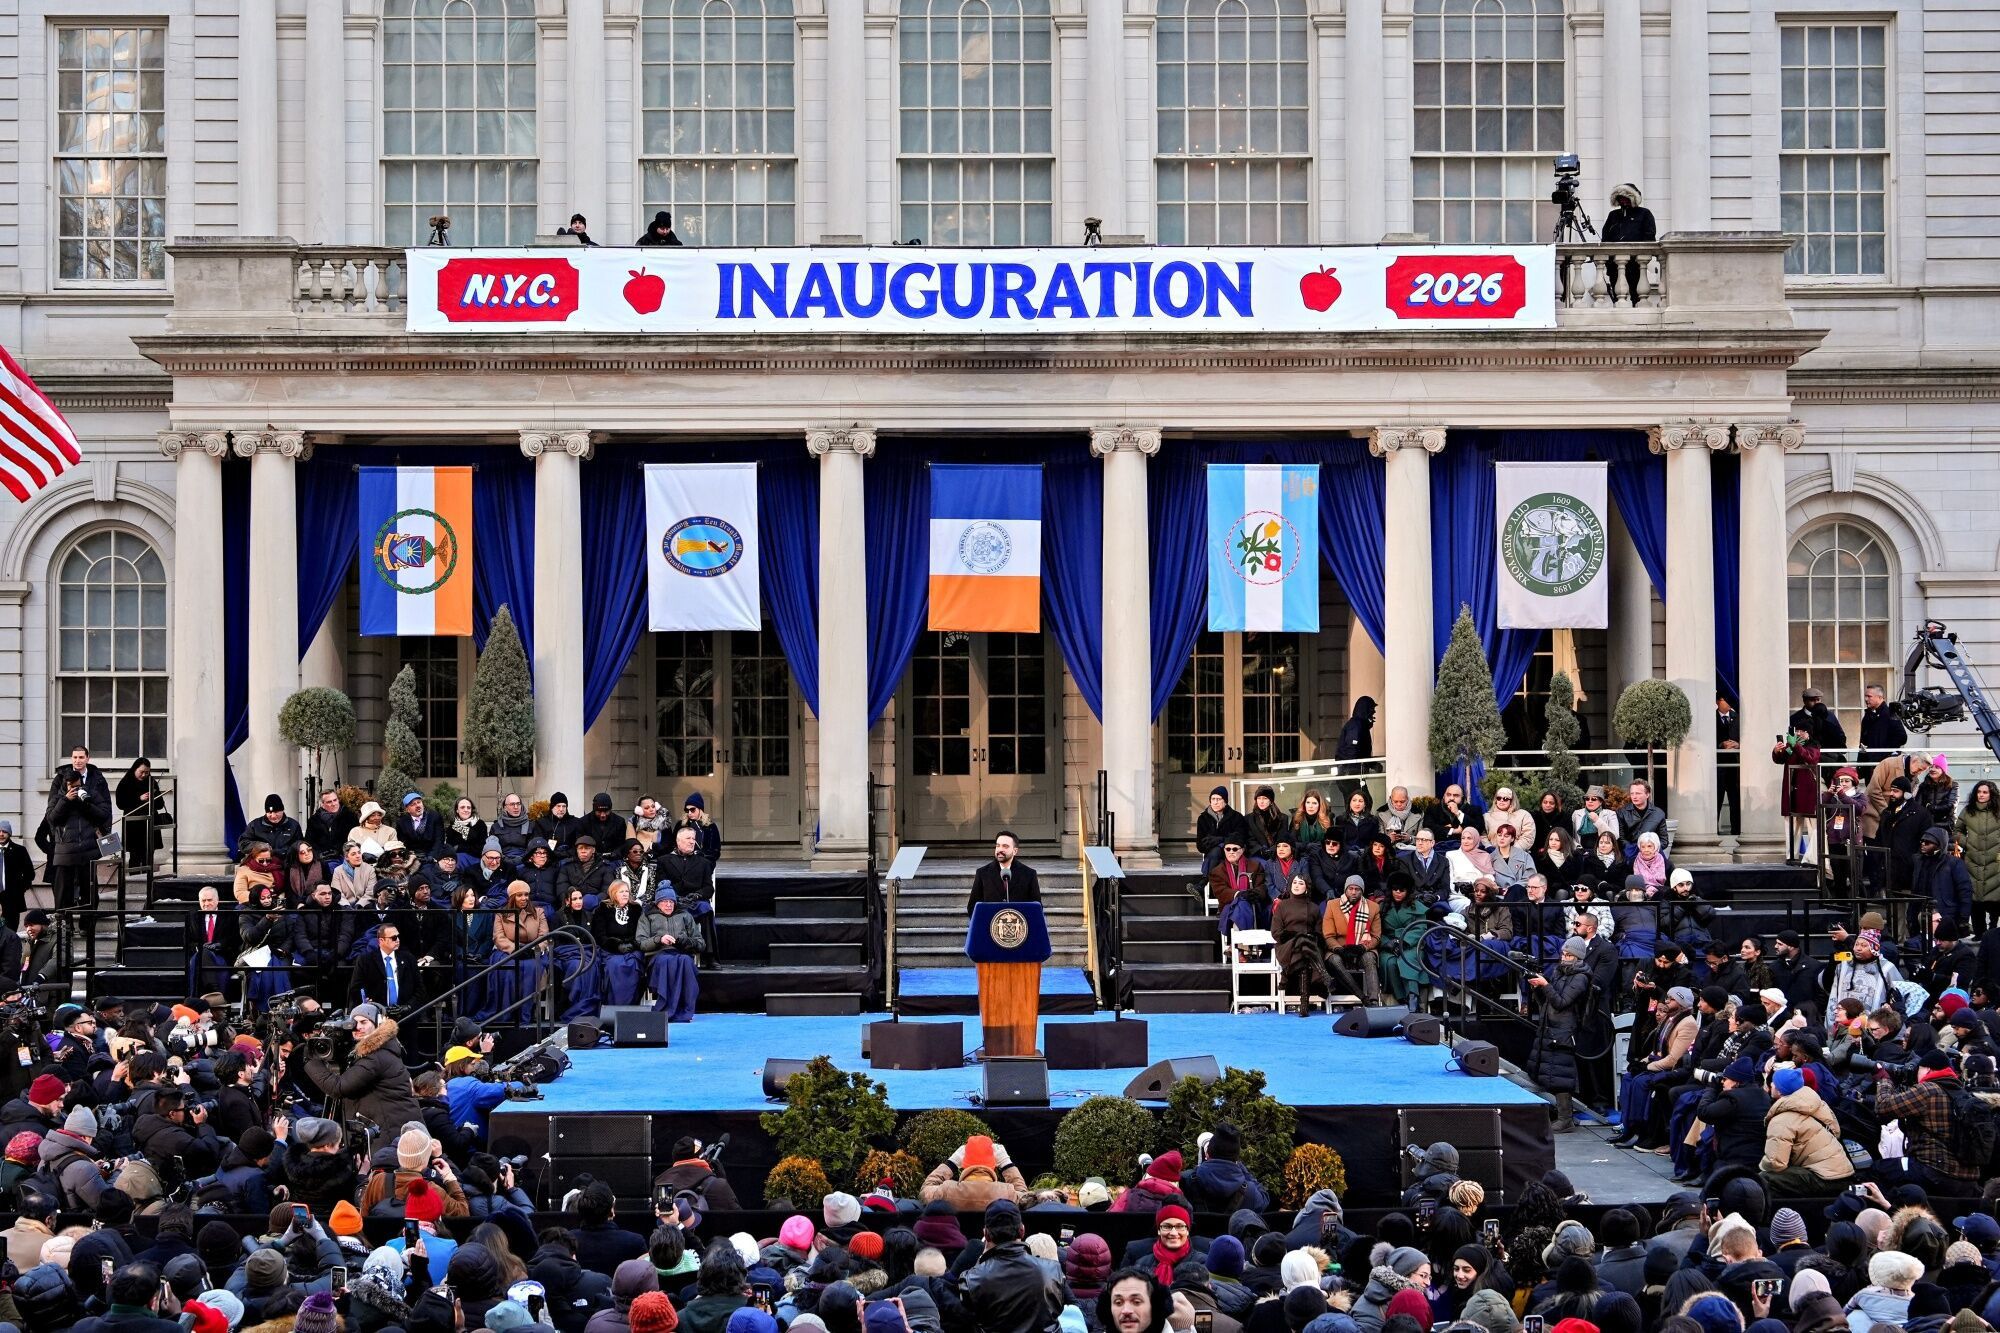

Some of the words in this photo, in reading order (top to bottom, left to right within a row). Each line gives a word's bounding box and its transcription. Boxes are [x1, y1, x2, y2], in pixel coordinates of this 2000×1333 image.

[461, 273, 560, 309] N.Y.C.
[716, 261, 1255, 319] INAUGURATION
[1406, 271, 1504, 307] 2026
[1511, 503, 1530, 524] CITY
[1552, 495, 1571, 506] 1609
[1578, 506, 1603, 544] STATEN
[1503, 534, 1513, 558] NEW
[1508, 559, 1531, 586] YORK
[1578, 547, 1603, 585] ISLAND
[1553, 583, 1572, 594] 1898
